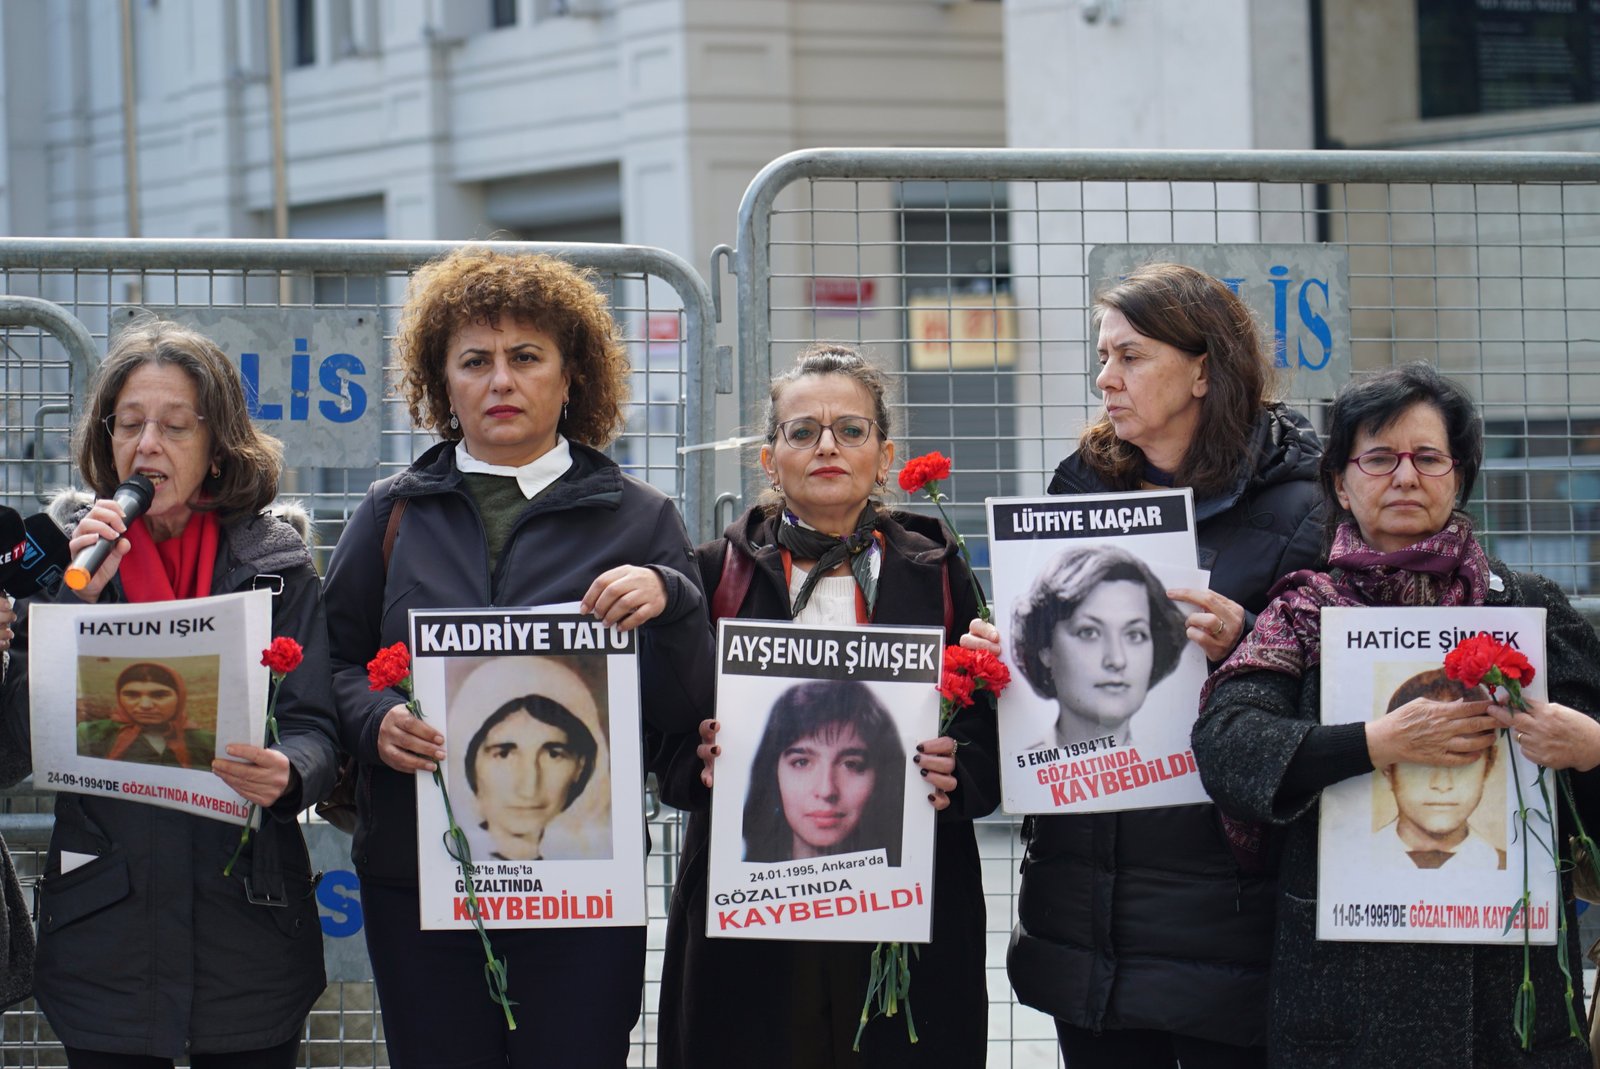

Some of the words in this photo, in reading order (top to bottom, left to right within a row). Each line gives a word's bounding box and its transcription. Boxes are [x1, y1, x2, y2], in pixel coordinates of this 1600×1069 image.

[240, 338, 368, 423] LİS
[1089, 505, 1163, 534] KAÇAR
[79, 620, 162, 637] HATUN
[169, 616, 216, 639] IŞIK
[420, 616, 550, 651] KADRİYE
[558, 621, 629, 650] TATU
[1346, 626, 1431, 650] HATİCE
[1438, 626, 1520, 654] ŞİEK
[726, 634, 840, 671] AYŞENUR
[844, 634, 936, 676] ŞİMŞEK
[1016, 755, 1026, 769] 5
[1063, 735, 1117, 758] 1994'TE
[1036, 747, 1142, 786] GÖZALTINDA
[47, 771, 120, 792] 24-09-1994'DE
[122, 781, 189, 804] GÖZALTINDA
[191, 792, 251, 820] KAYBEDİLD
[498, 864, 533, 877] Muş'ta
[749, 864, 819, 883] 24.01.1995,
[821, 855, 885, 873] Ankara'da
[453, 889, 613, 921] KAYBEDİLDİ
[713, 878, 853, 907] GÖZALTINDA
[717, 882, 925, 931] KAYBEDİLDİ
[1333, 903, 1406, 928] 11-05-1995'DE
[1409, 900, 1480, 930] GÖZALTINDA
